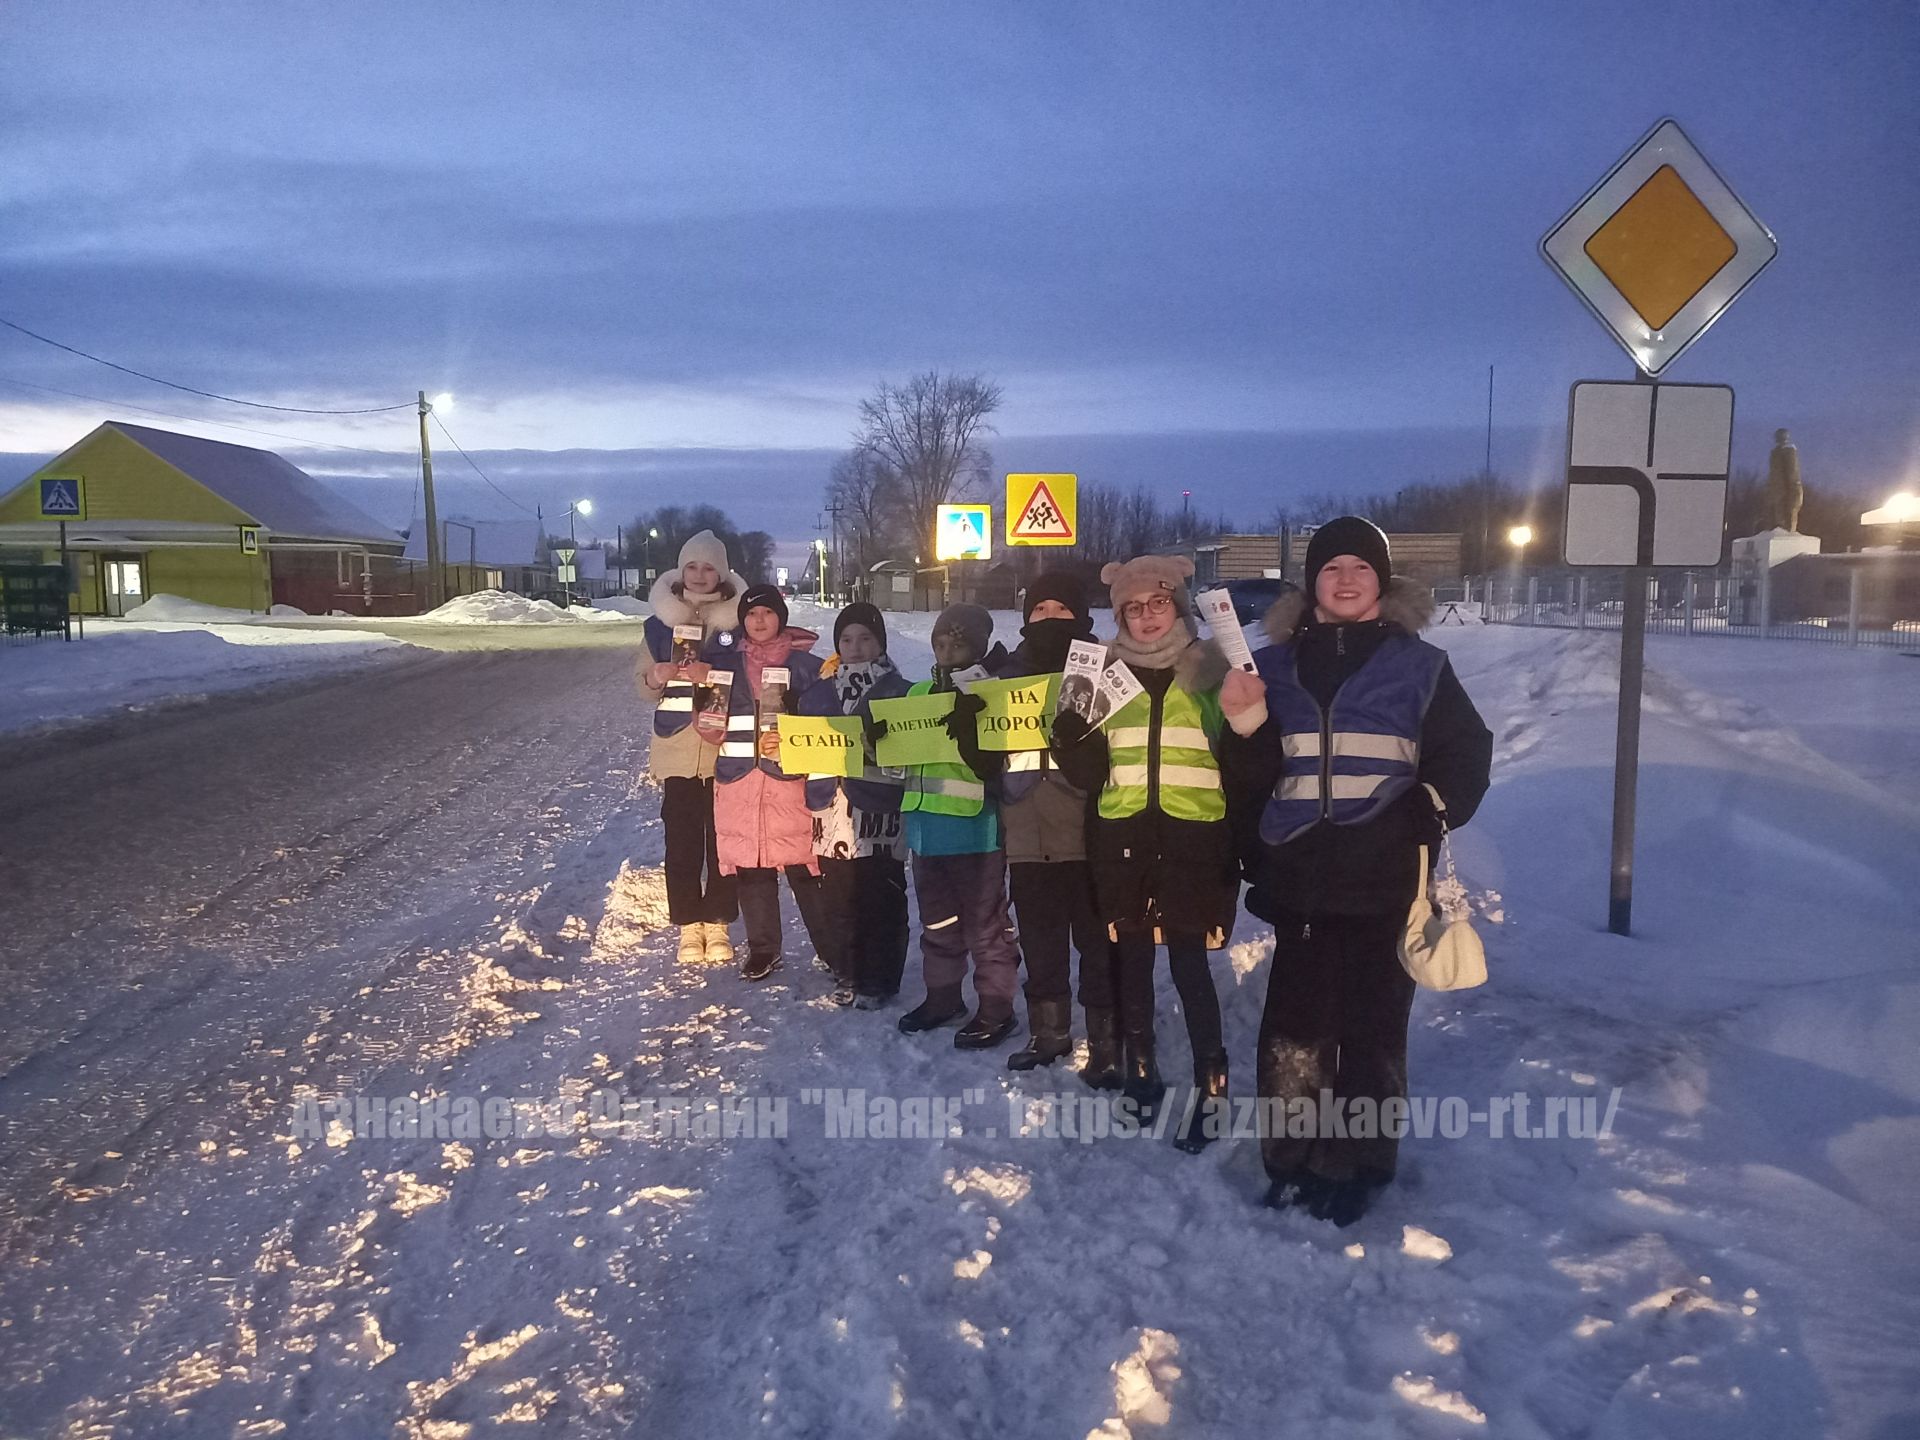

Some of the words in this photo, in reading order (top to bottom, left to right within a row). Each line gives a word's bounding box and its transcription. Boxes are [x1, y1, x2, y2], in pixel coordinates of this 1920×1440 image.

[1010, 690, 1040, 704] НА
[887, 714, 947, 733] АМЕТНЕ
[984, 713, 1056, 734] ДОРОГ
[789, 734, 855, 748] СТАНЬ
